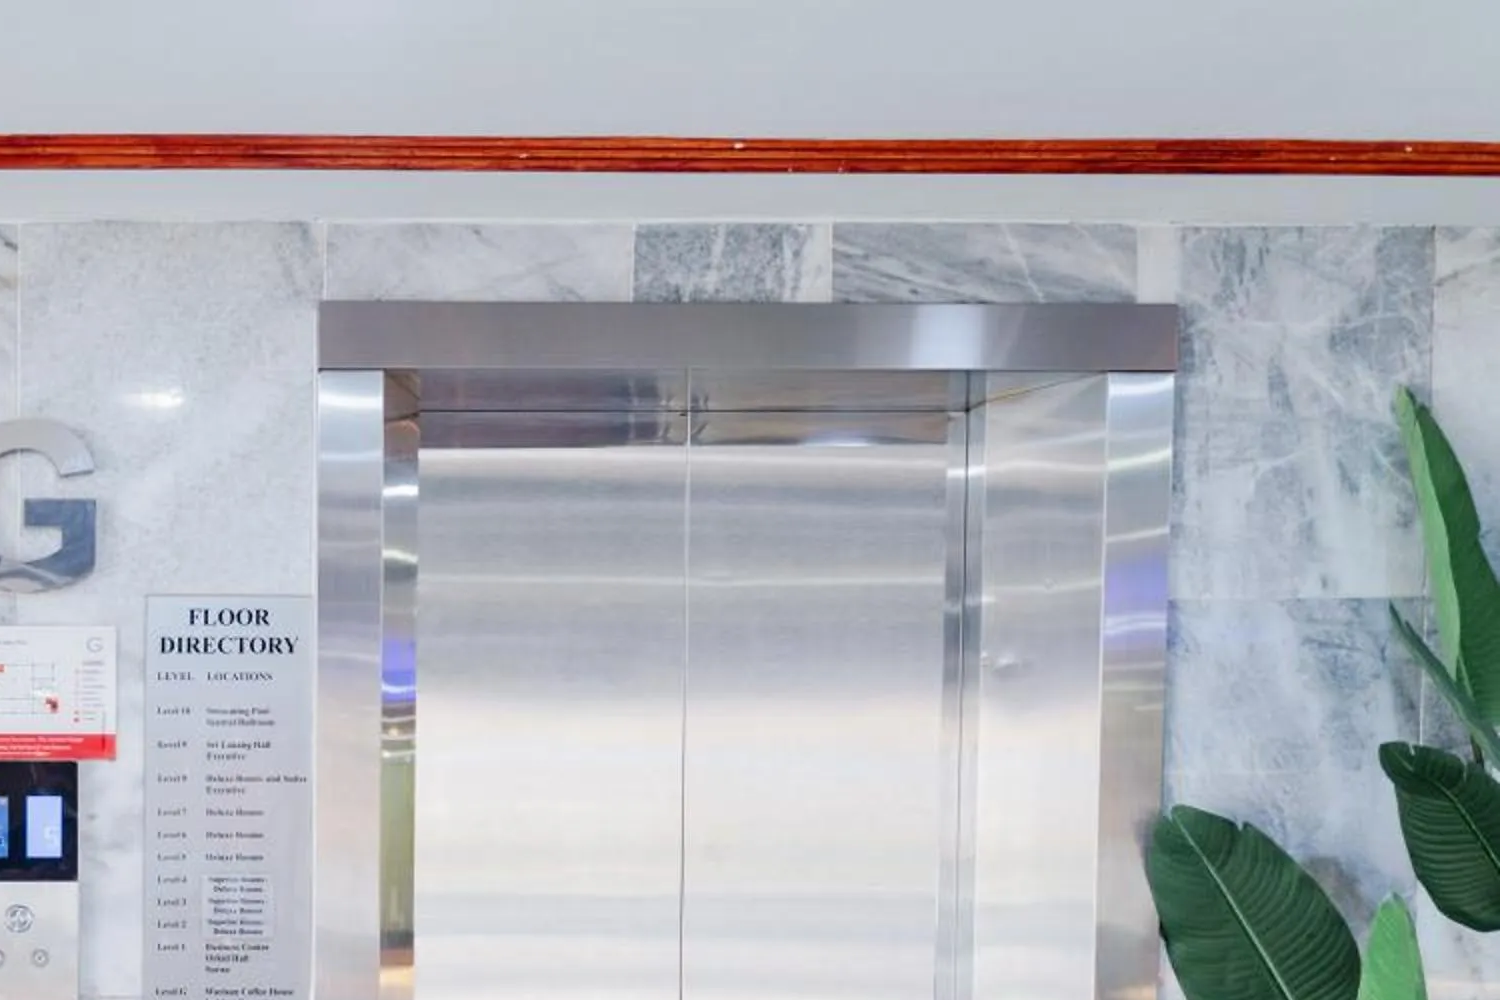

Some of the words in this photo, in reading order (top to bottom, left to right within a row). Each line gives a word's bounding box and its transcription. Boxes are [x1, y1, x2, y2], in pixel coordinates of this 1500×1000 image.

[188, 607, 270, 626] FLOOR
[159, 635, 299, 655] DIRECTORY
[157, 671, 194, 681] LEVEL
[207, 671, 274, 681] LOCATIONS
